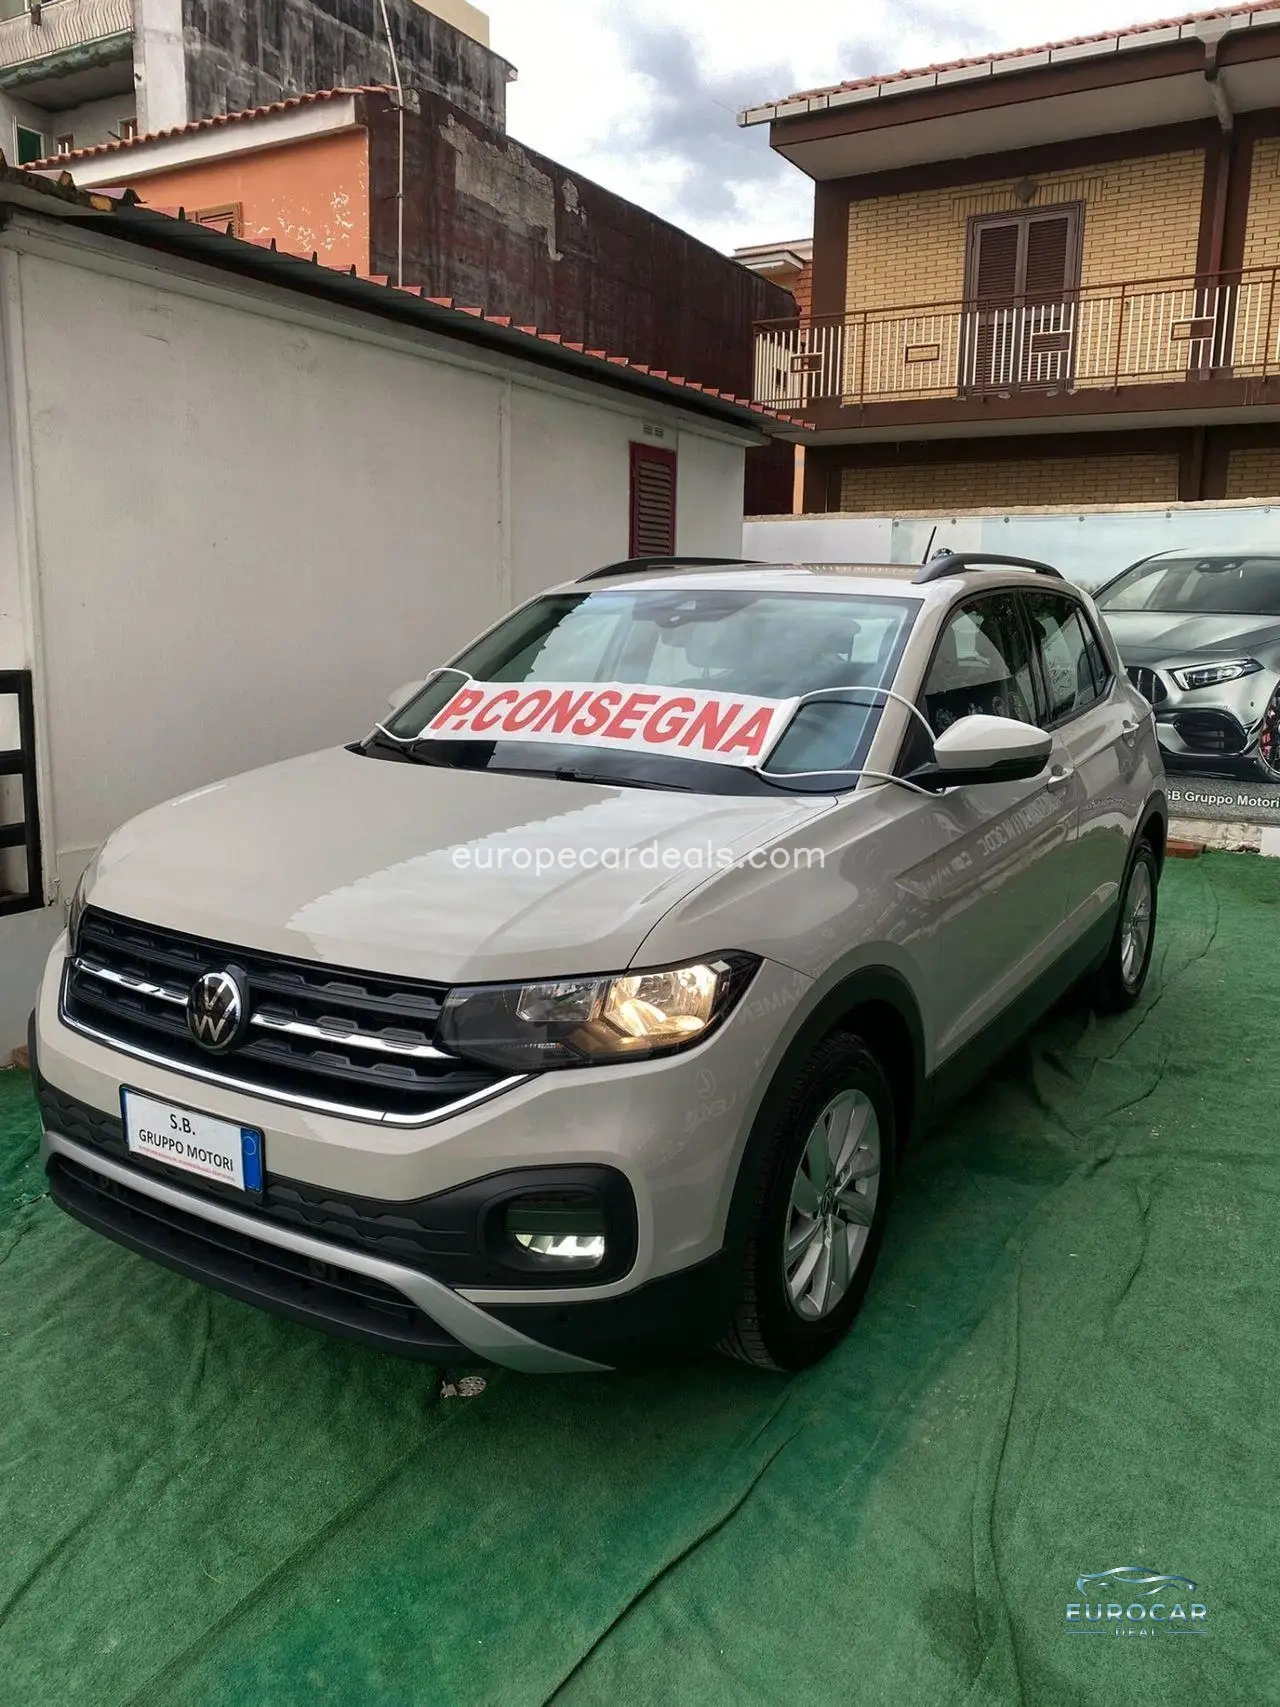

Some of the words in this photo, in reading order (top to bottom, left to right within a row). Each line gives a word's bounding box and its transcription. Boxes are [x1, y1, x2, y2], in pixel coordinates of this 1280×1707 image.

[431, 688, 775, 756] P.CONSEGNA
[1184, 791, 1234, 806] Gruppo
[1237, 795, 1280, 808] Motori
[169, 1113, 196, 1136] S.B.
[138, 1128, 184, 1154] GRUPPO
[187, 1144, 234, 1172] MOTORI
